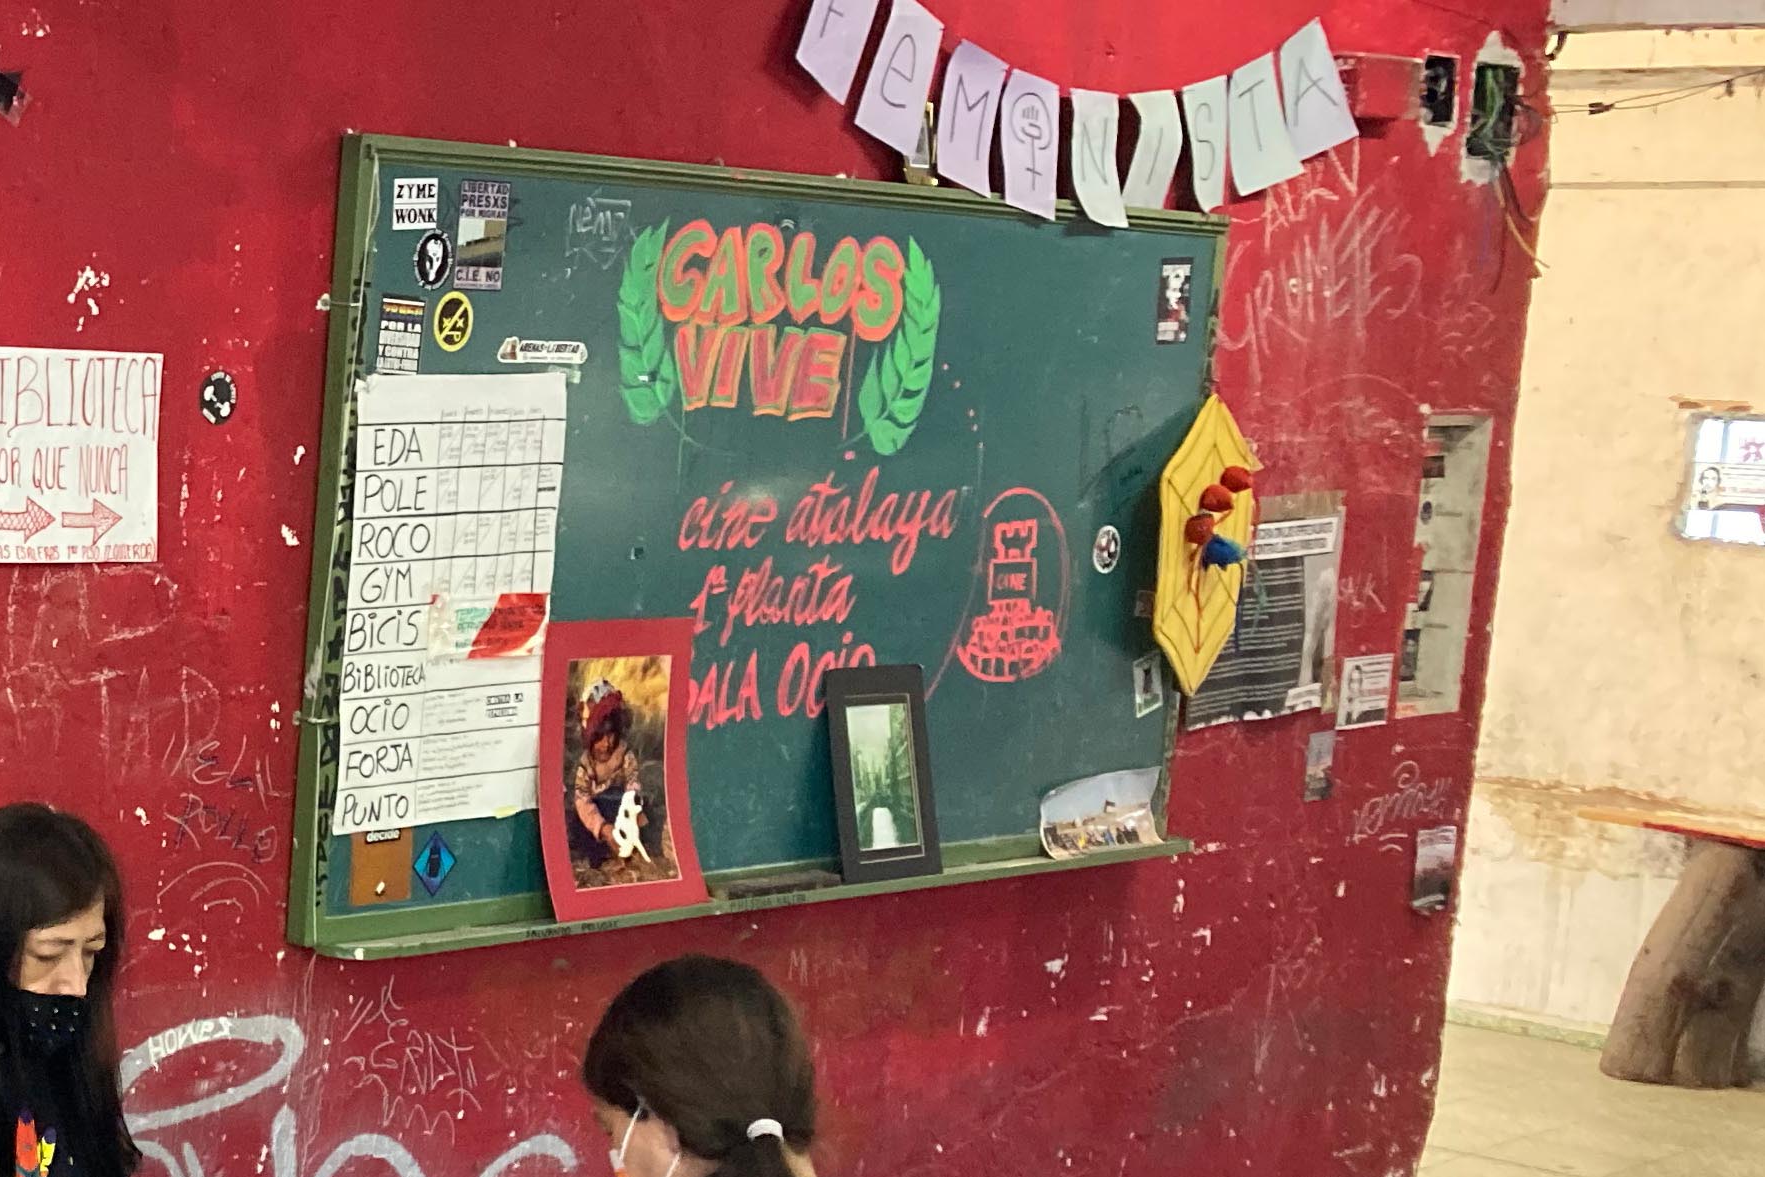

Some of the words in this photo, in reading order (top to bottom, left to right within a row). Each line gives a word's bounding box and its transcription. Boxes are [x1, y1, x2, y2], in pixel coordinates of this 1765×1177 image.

[396, 184, 437, 199] ZYME
[462, 194, 507, 208] PRESXS
[463, 182, 509, 194] LIBERTAD
[395, 208, 437, 224] WONK
[658, 219, 905, 341] CARLOS
[675, 324, 847, 421] VIVE
[374, 427, 423, 466] EDA
[32, 446, 70, 492] QUE
[78, 444, 128, 500] NUNCA
[363, 474, 428, 513] POLE
[786, 466, 957, 575] atalaya
[358, 523, 430, 559] ROCO
[360, 563, 413, 603] GYM
[719, 556, 857, 647] planta
[345, 743, 414, 781] FORJA
[342, 794, 409, 827] PUNTO
